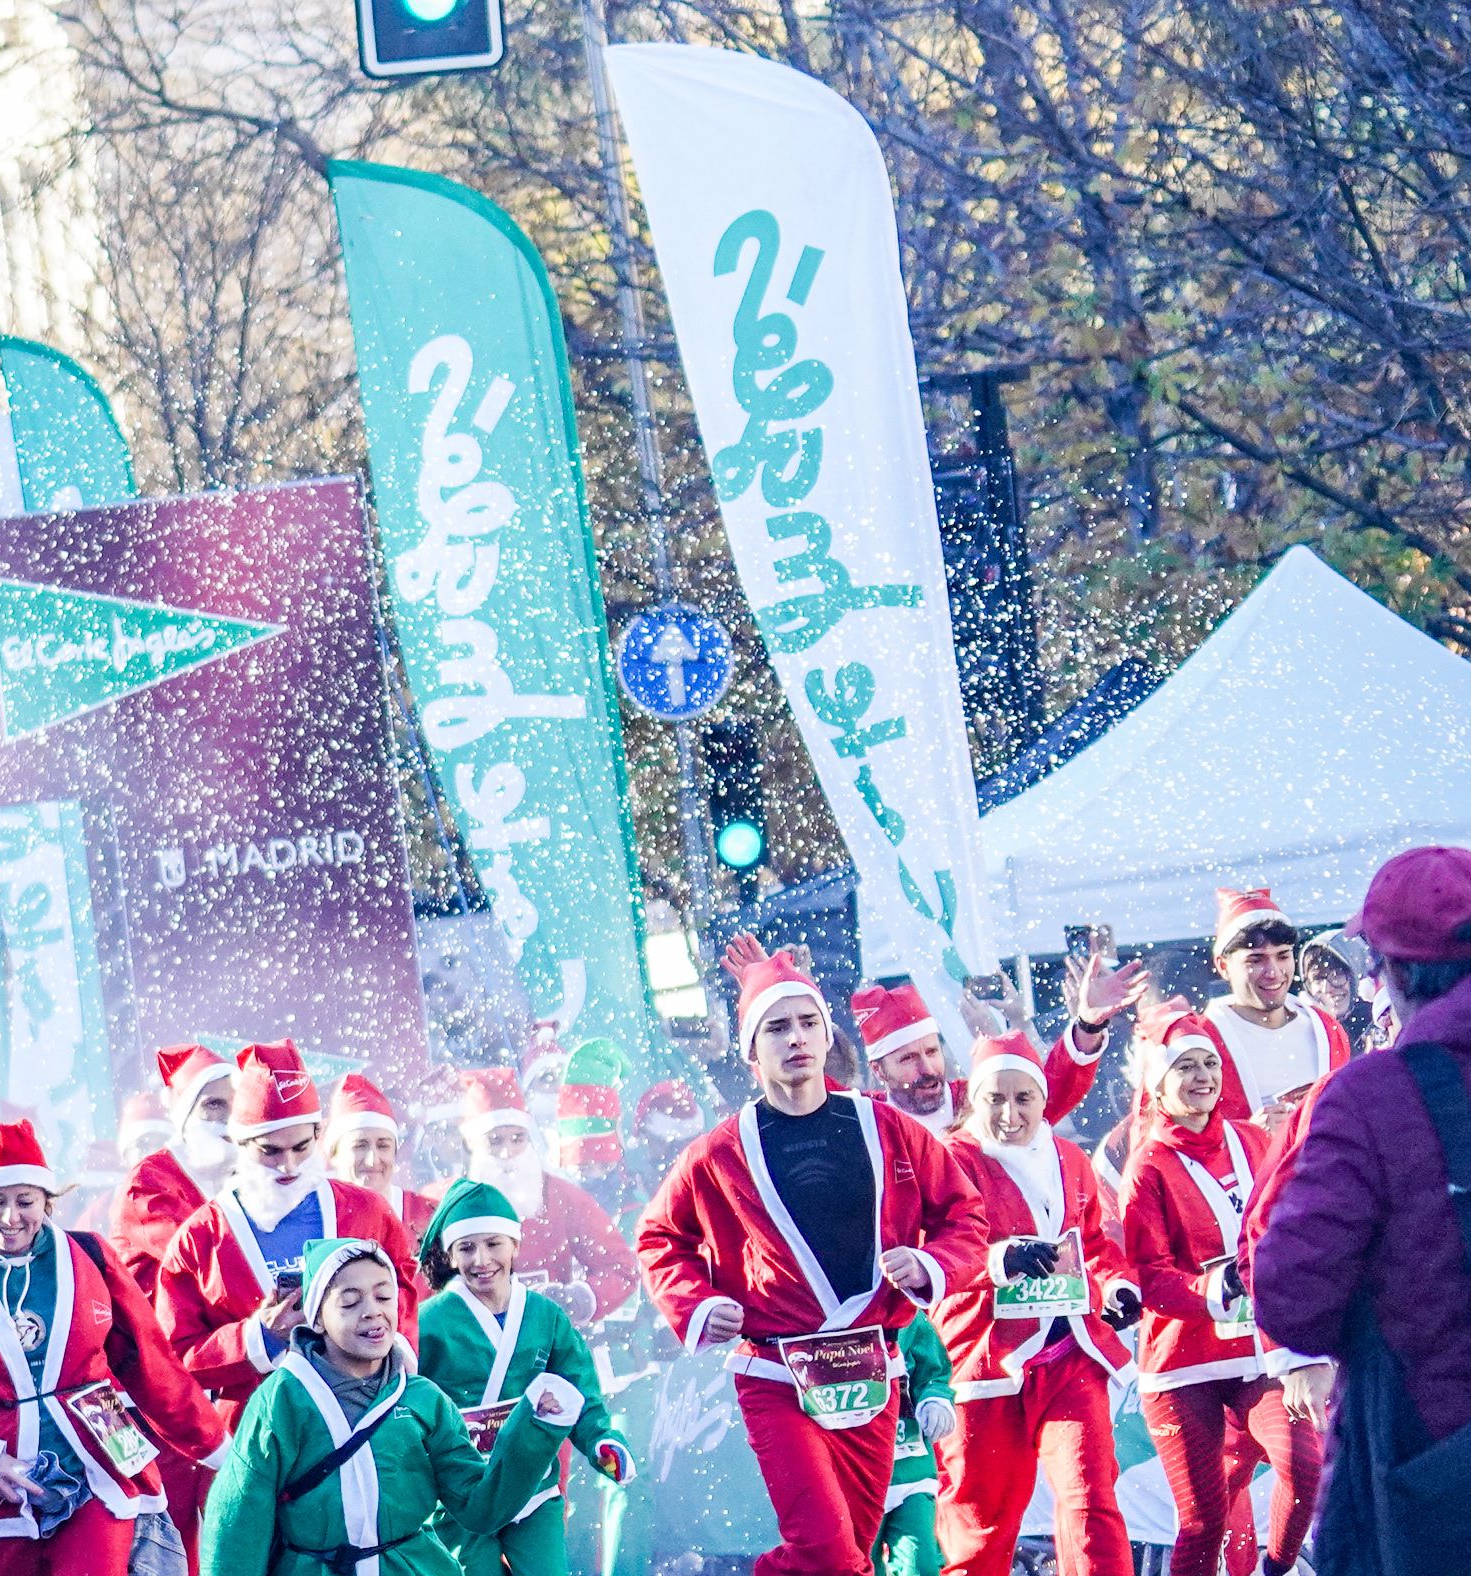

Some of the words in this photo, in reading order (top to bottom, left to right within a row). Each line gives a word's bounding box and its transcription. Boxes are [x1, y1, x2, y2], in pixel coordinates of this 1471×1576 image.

[2, 634, 36, 670] El
[36, 632, 109, 668] Corte
[111, 613, 216, 673] Inglés
[208, 830, 365, 880] MADRID
[1016, 1277, 1069, 1302] 3422
[814, 1346, 845, 1362] Papá
[848, 1343, 874, 1357] Noel
